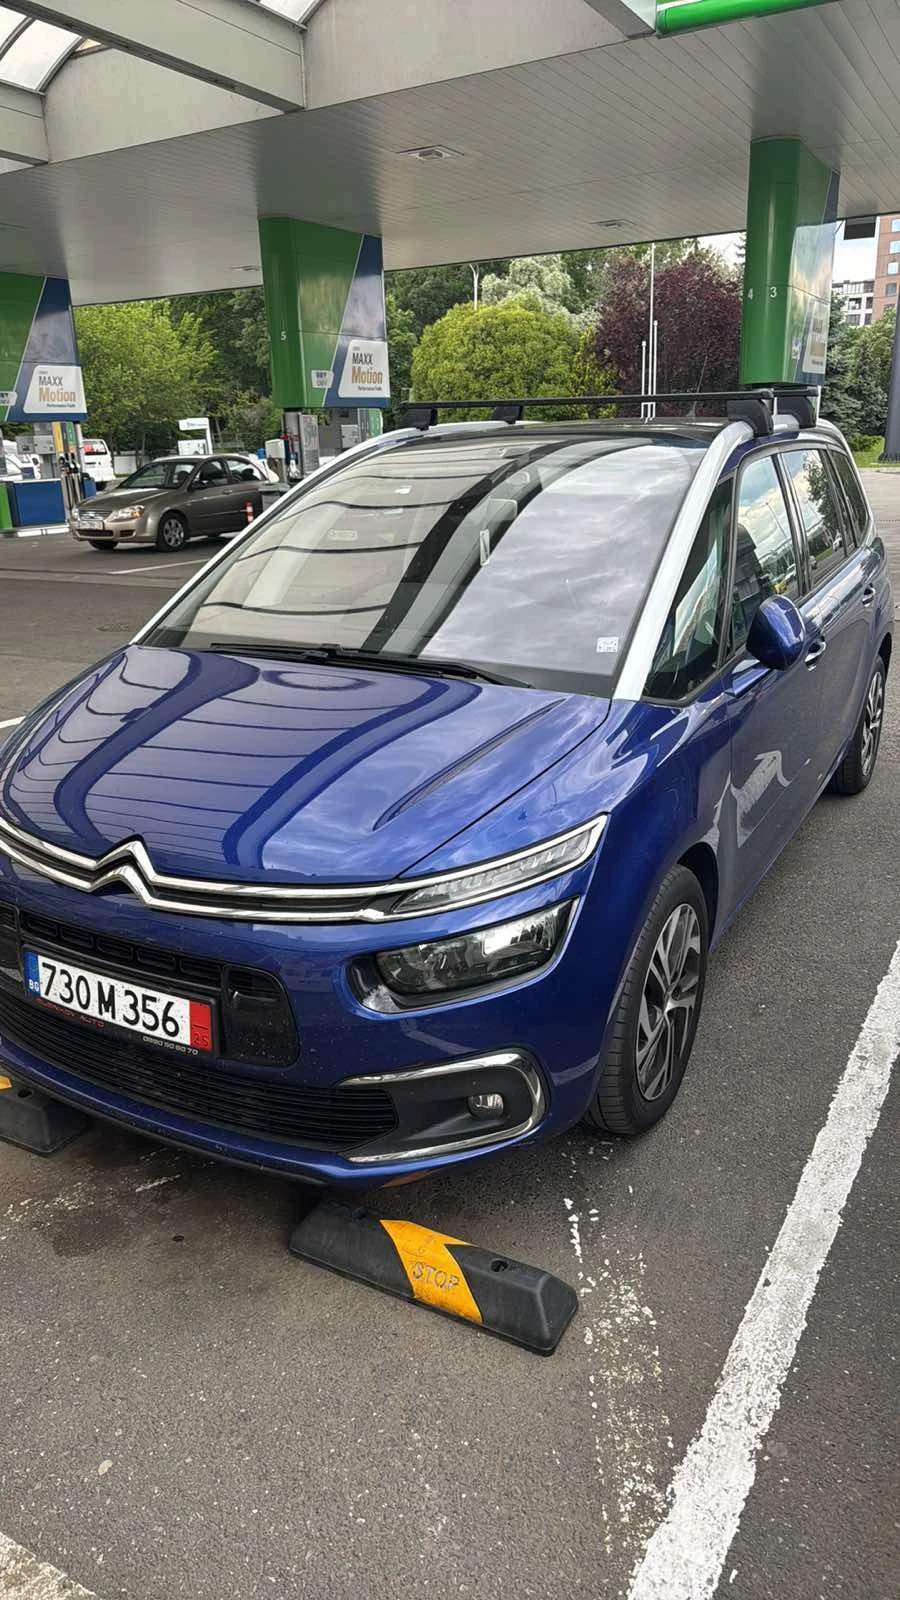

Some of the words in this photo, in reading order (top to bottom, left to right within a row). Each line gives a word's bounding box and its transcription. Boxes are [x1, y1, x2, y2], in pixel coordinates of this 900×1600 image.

[770, 286, 777, 298] 3
[281, 331, 287, 341] 5
[352, 352, 374, 365] MAXX
[39, 376, 63, 386] MAXX
[351, 366, 383, 385] Motion
[38, 388, 76, 402] Motion
[28, 979, 40, 992] BG
[42, 962, 91, 1010] 730
[97, 981, 116, 1020] M
[122, 989, 180, 1037] 356
[192, 1032, 209, 1047] 25
[412, 1260, 460, 1290] STOP
